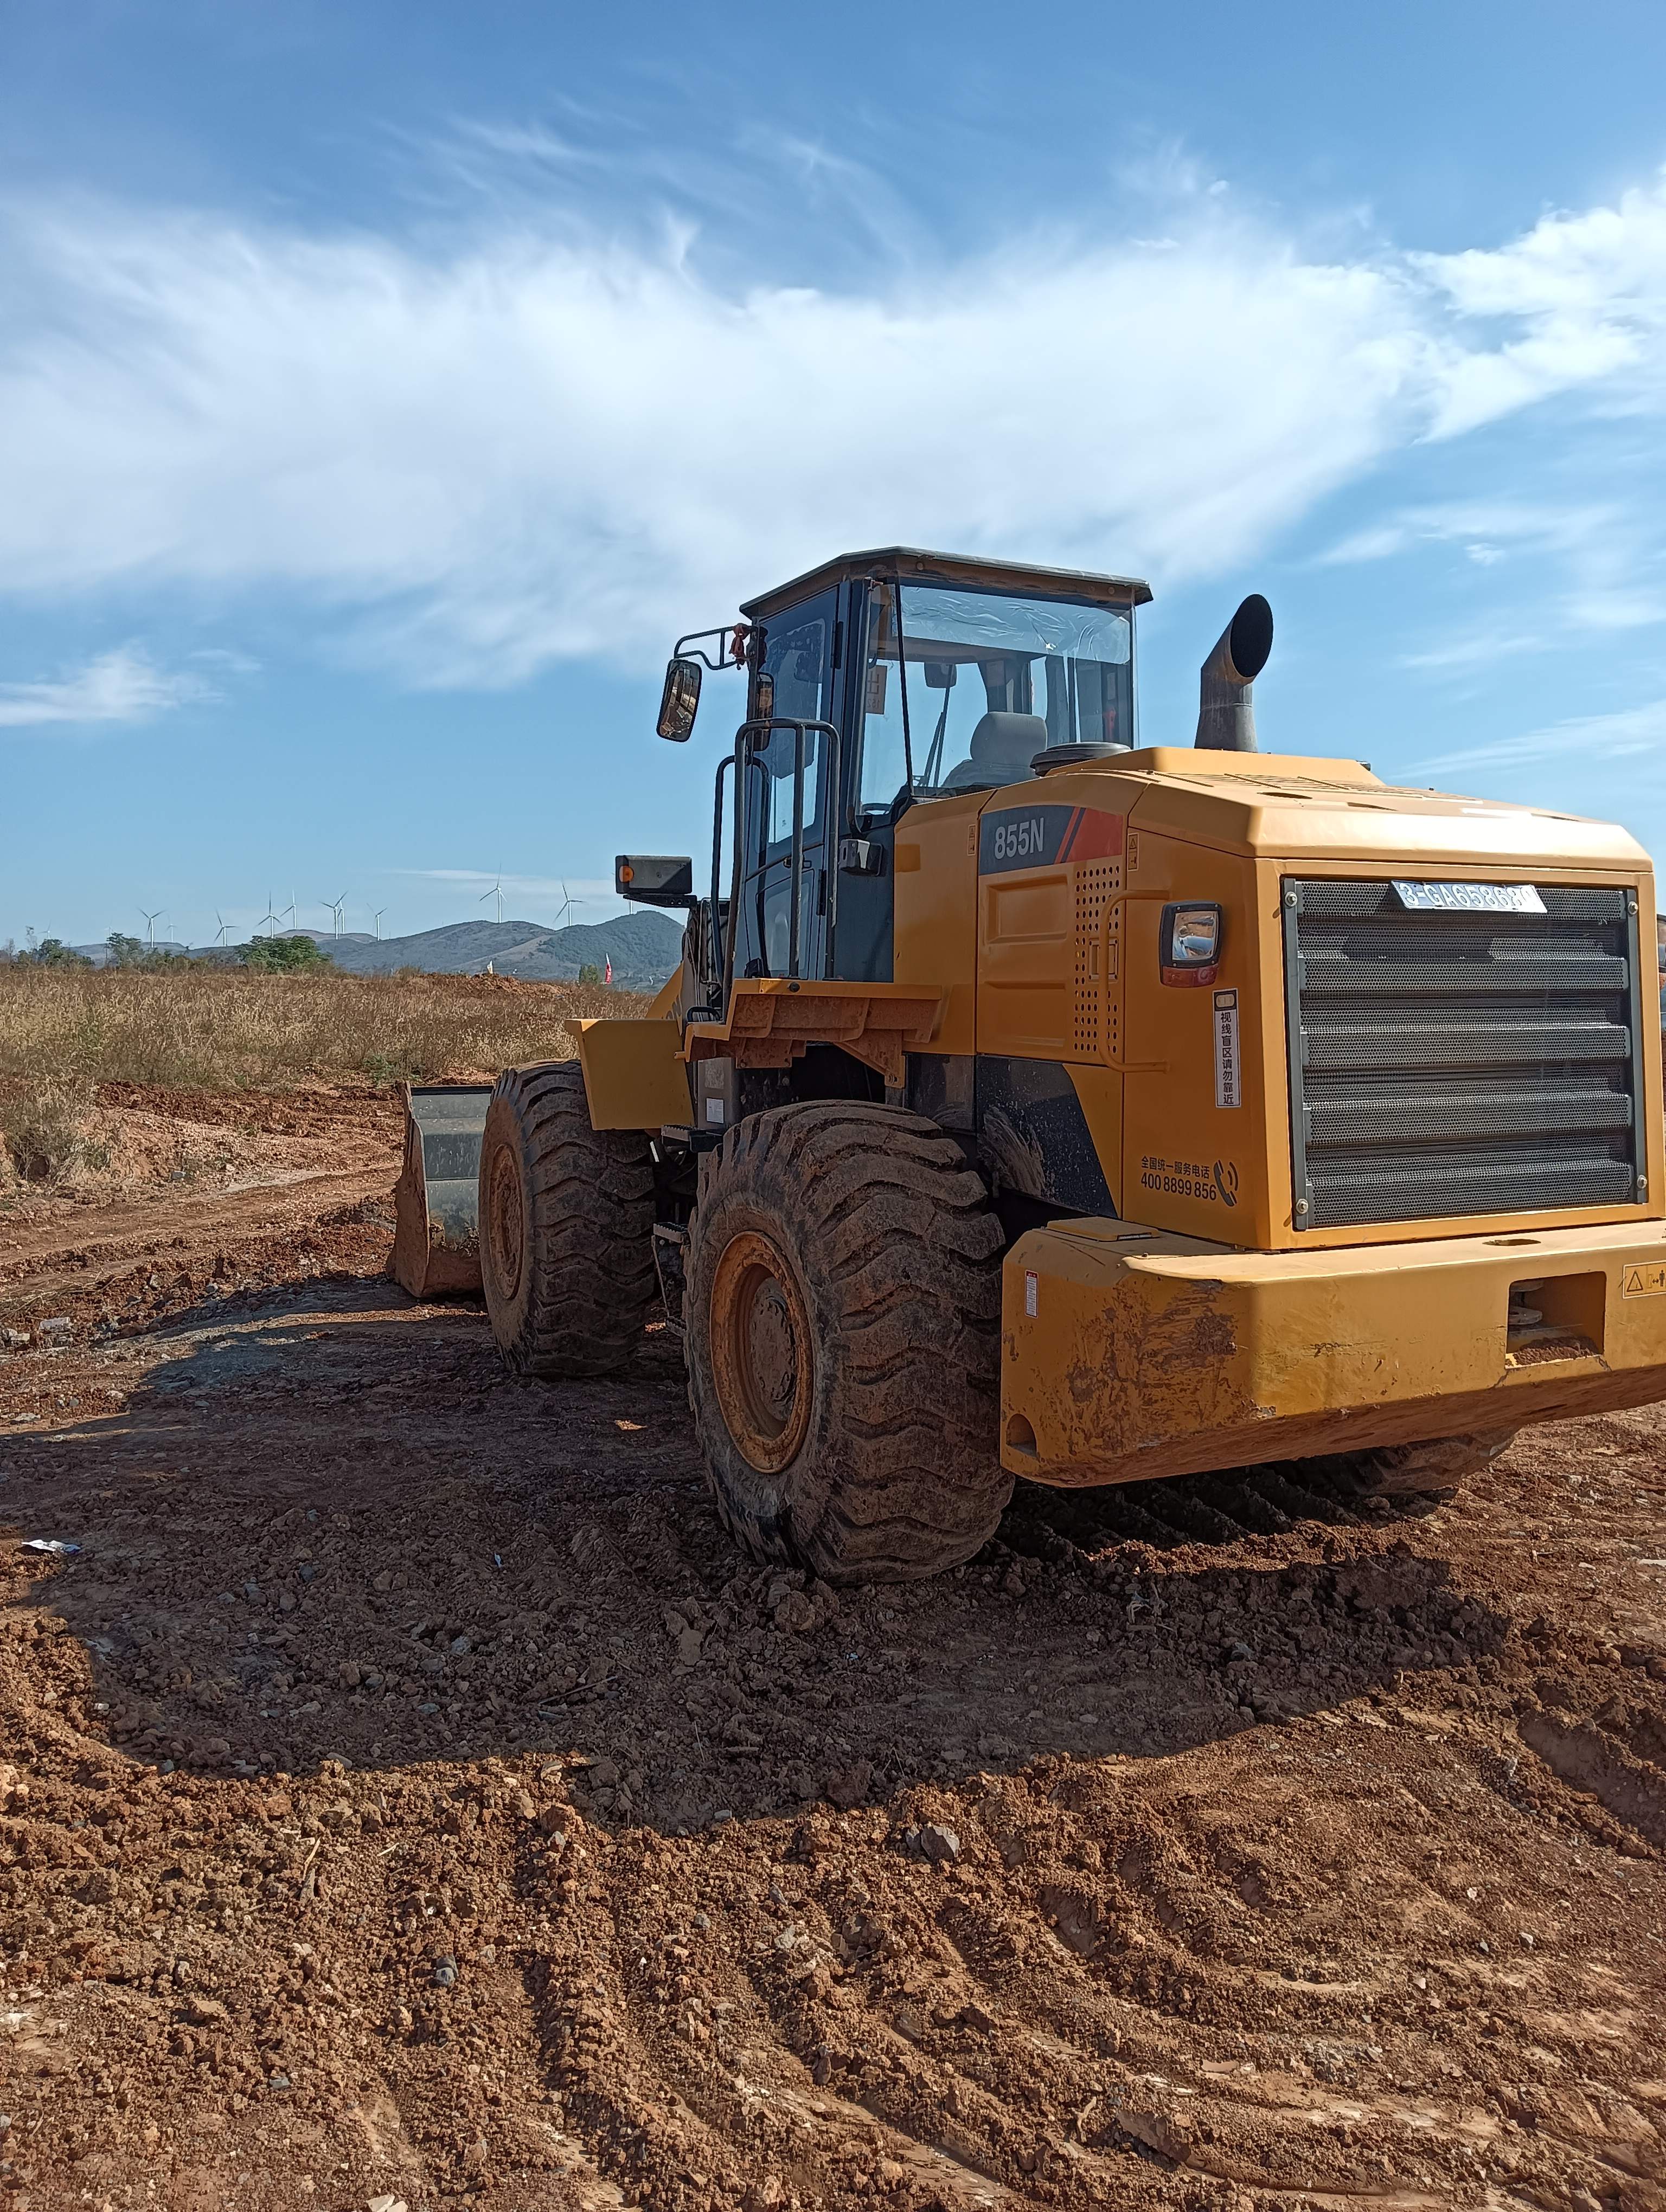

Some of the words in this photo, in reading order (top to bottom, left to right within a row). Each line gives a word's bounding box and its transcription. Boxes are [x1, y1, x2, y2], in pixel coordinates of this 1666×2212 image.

[994, 818, 1044, 860] 855N
[1221, 1012, 1234, 1104] 视线盲区请勿靠近
[1141, 1155, 1209, 1179] 全国统一服务电话
[1140, 1172, 1161, 1190] 400
[1163, 1176, 1192, 1195] 8899
[1194, 1181, 1216, 1200] 856
